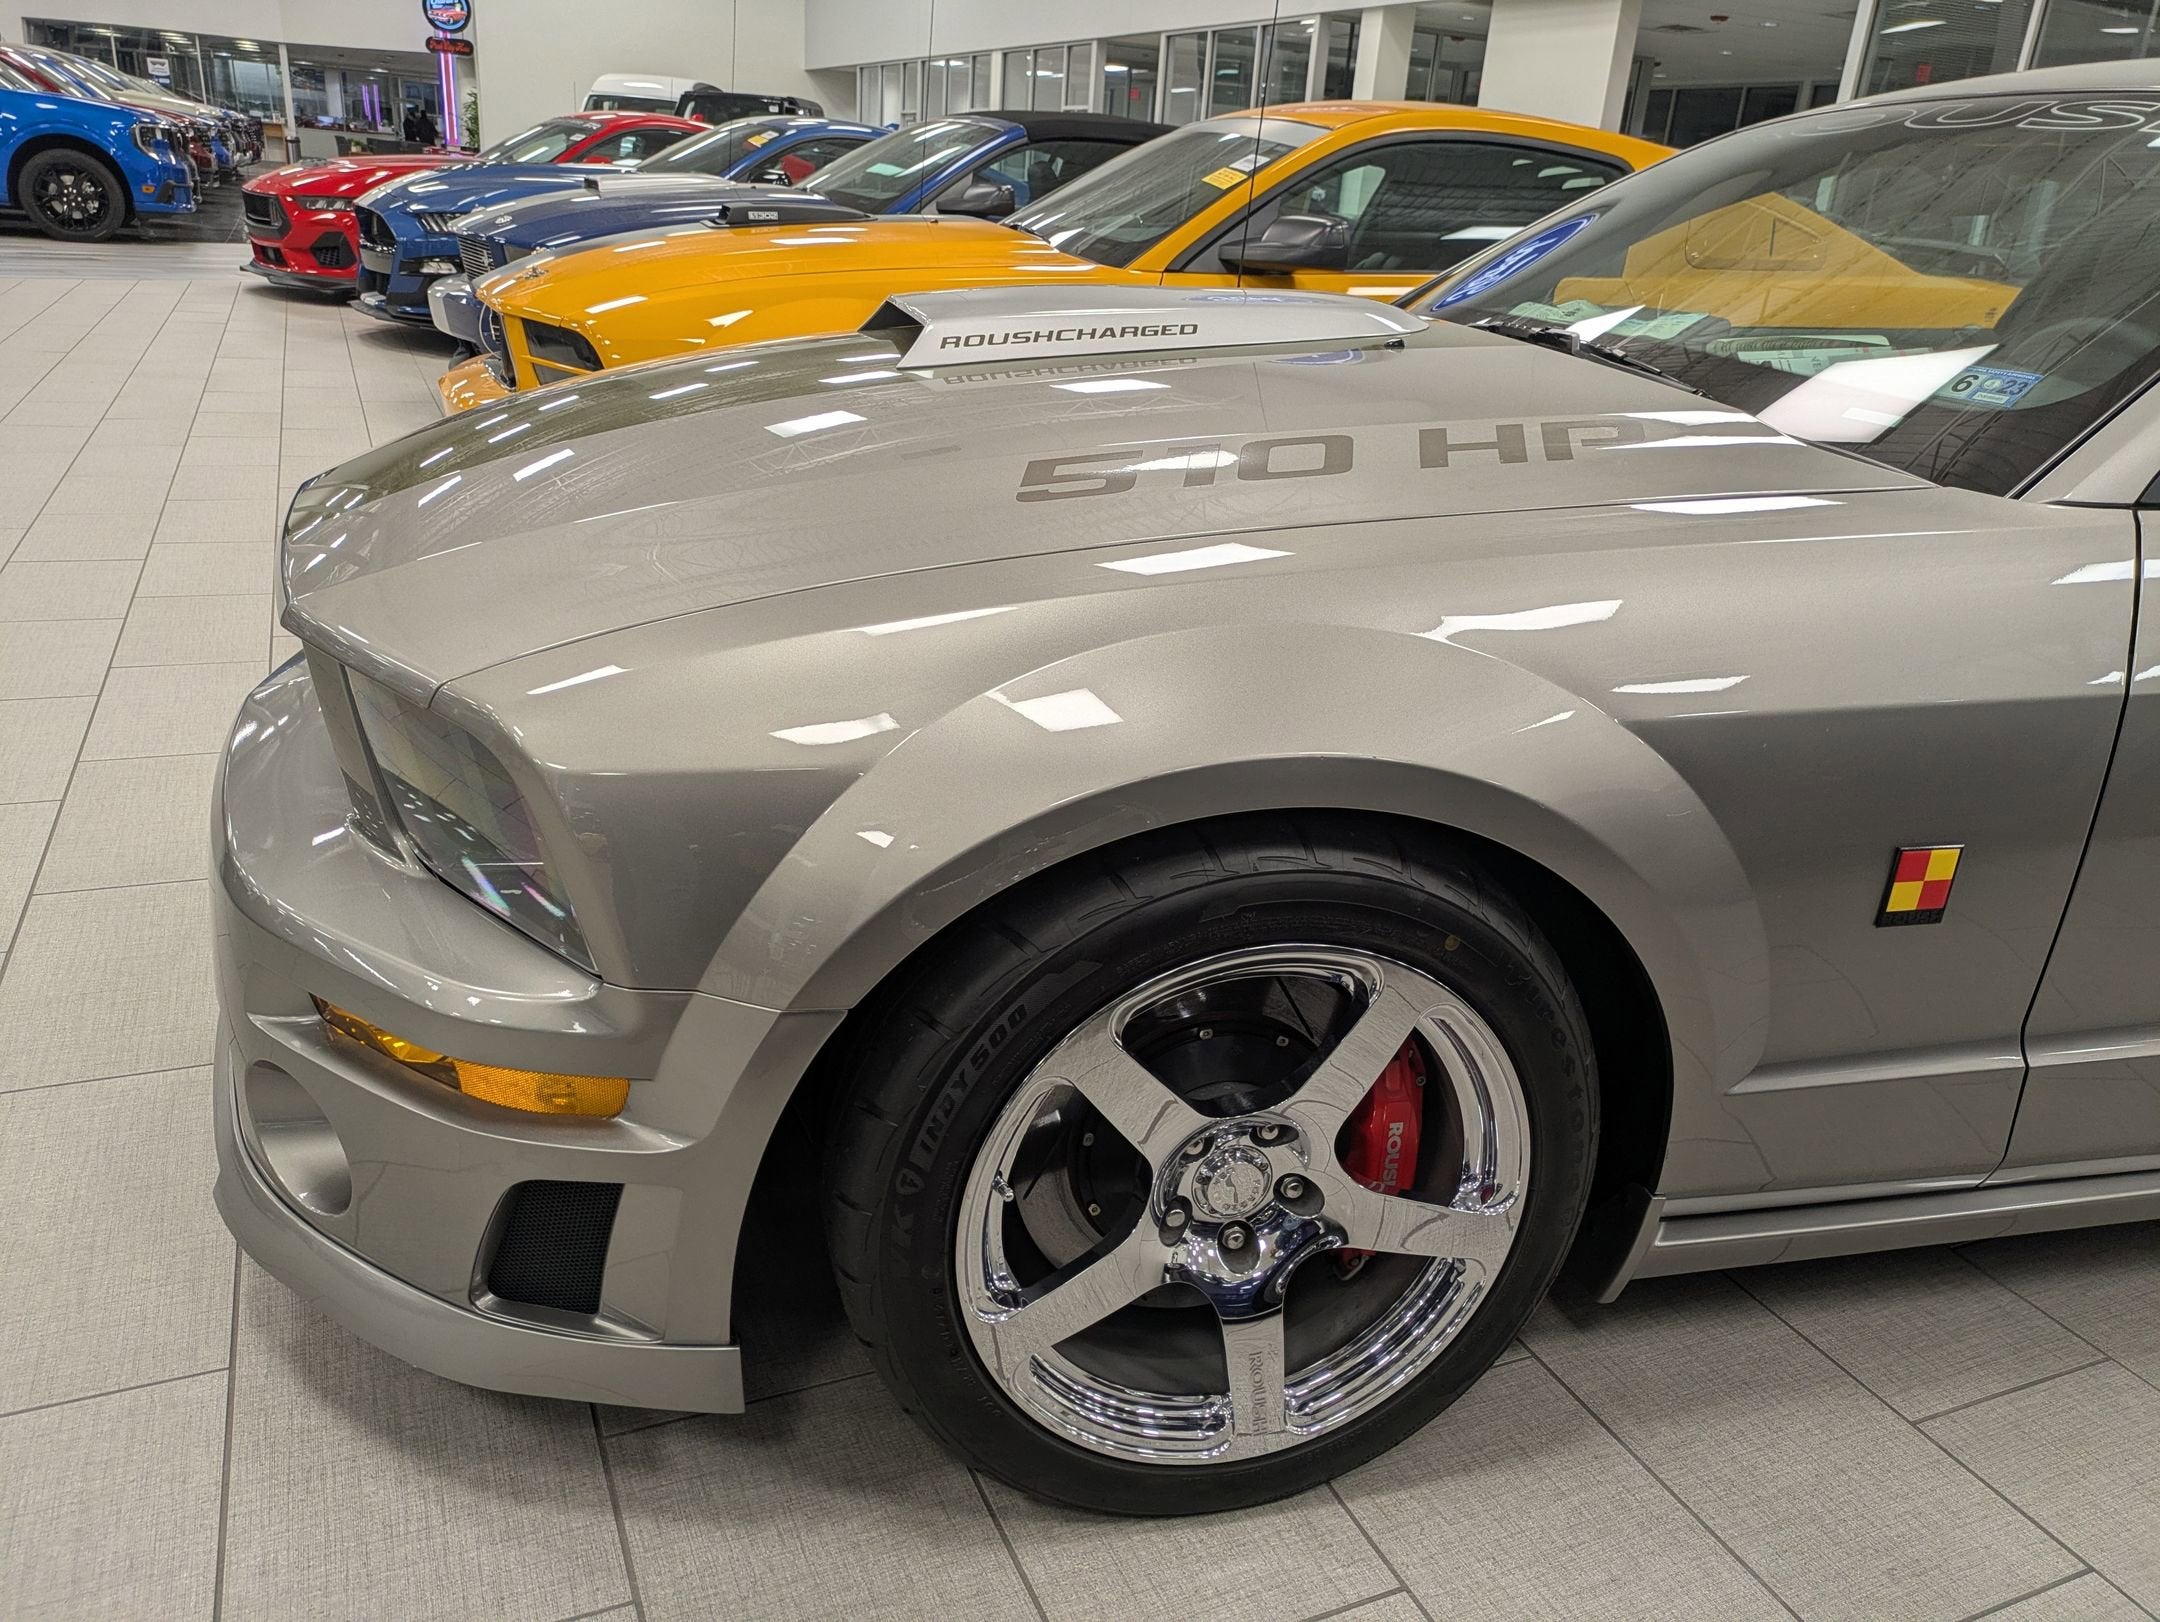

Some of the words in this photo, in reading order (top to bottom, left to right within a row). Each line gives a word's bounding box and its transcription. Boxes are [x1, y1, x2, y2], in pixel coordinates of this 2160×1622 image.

[1788, 100, 2160, 137] OUS
[940, 324, 1199, 349] ROUSHCHARGED
[1951, 374, 1980, 393] 6
[1996, 379, 2030, 396] 23
[1016, 434, 1354, 502] 510
[1418, 419, 1647, 469] HP
[919, 1071, 970, 1155] INDY
[969, 1003, 1028, 1072] 500
[1248, 1351, 1269, 1437] ROUSH
